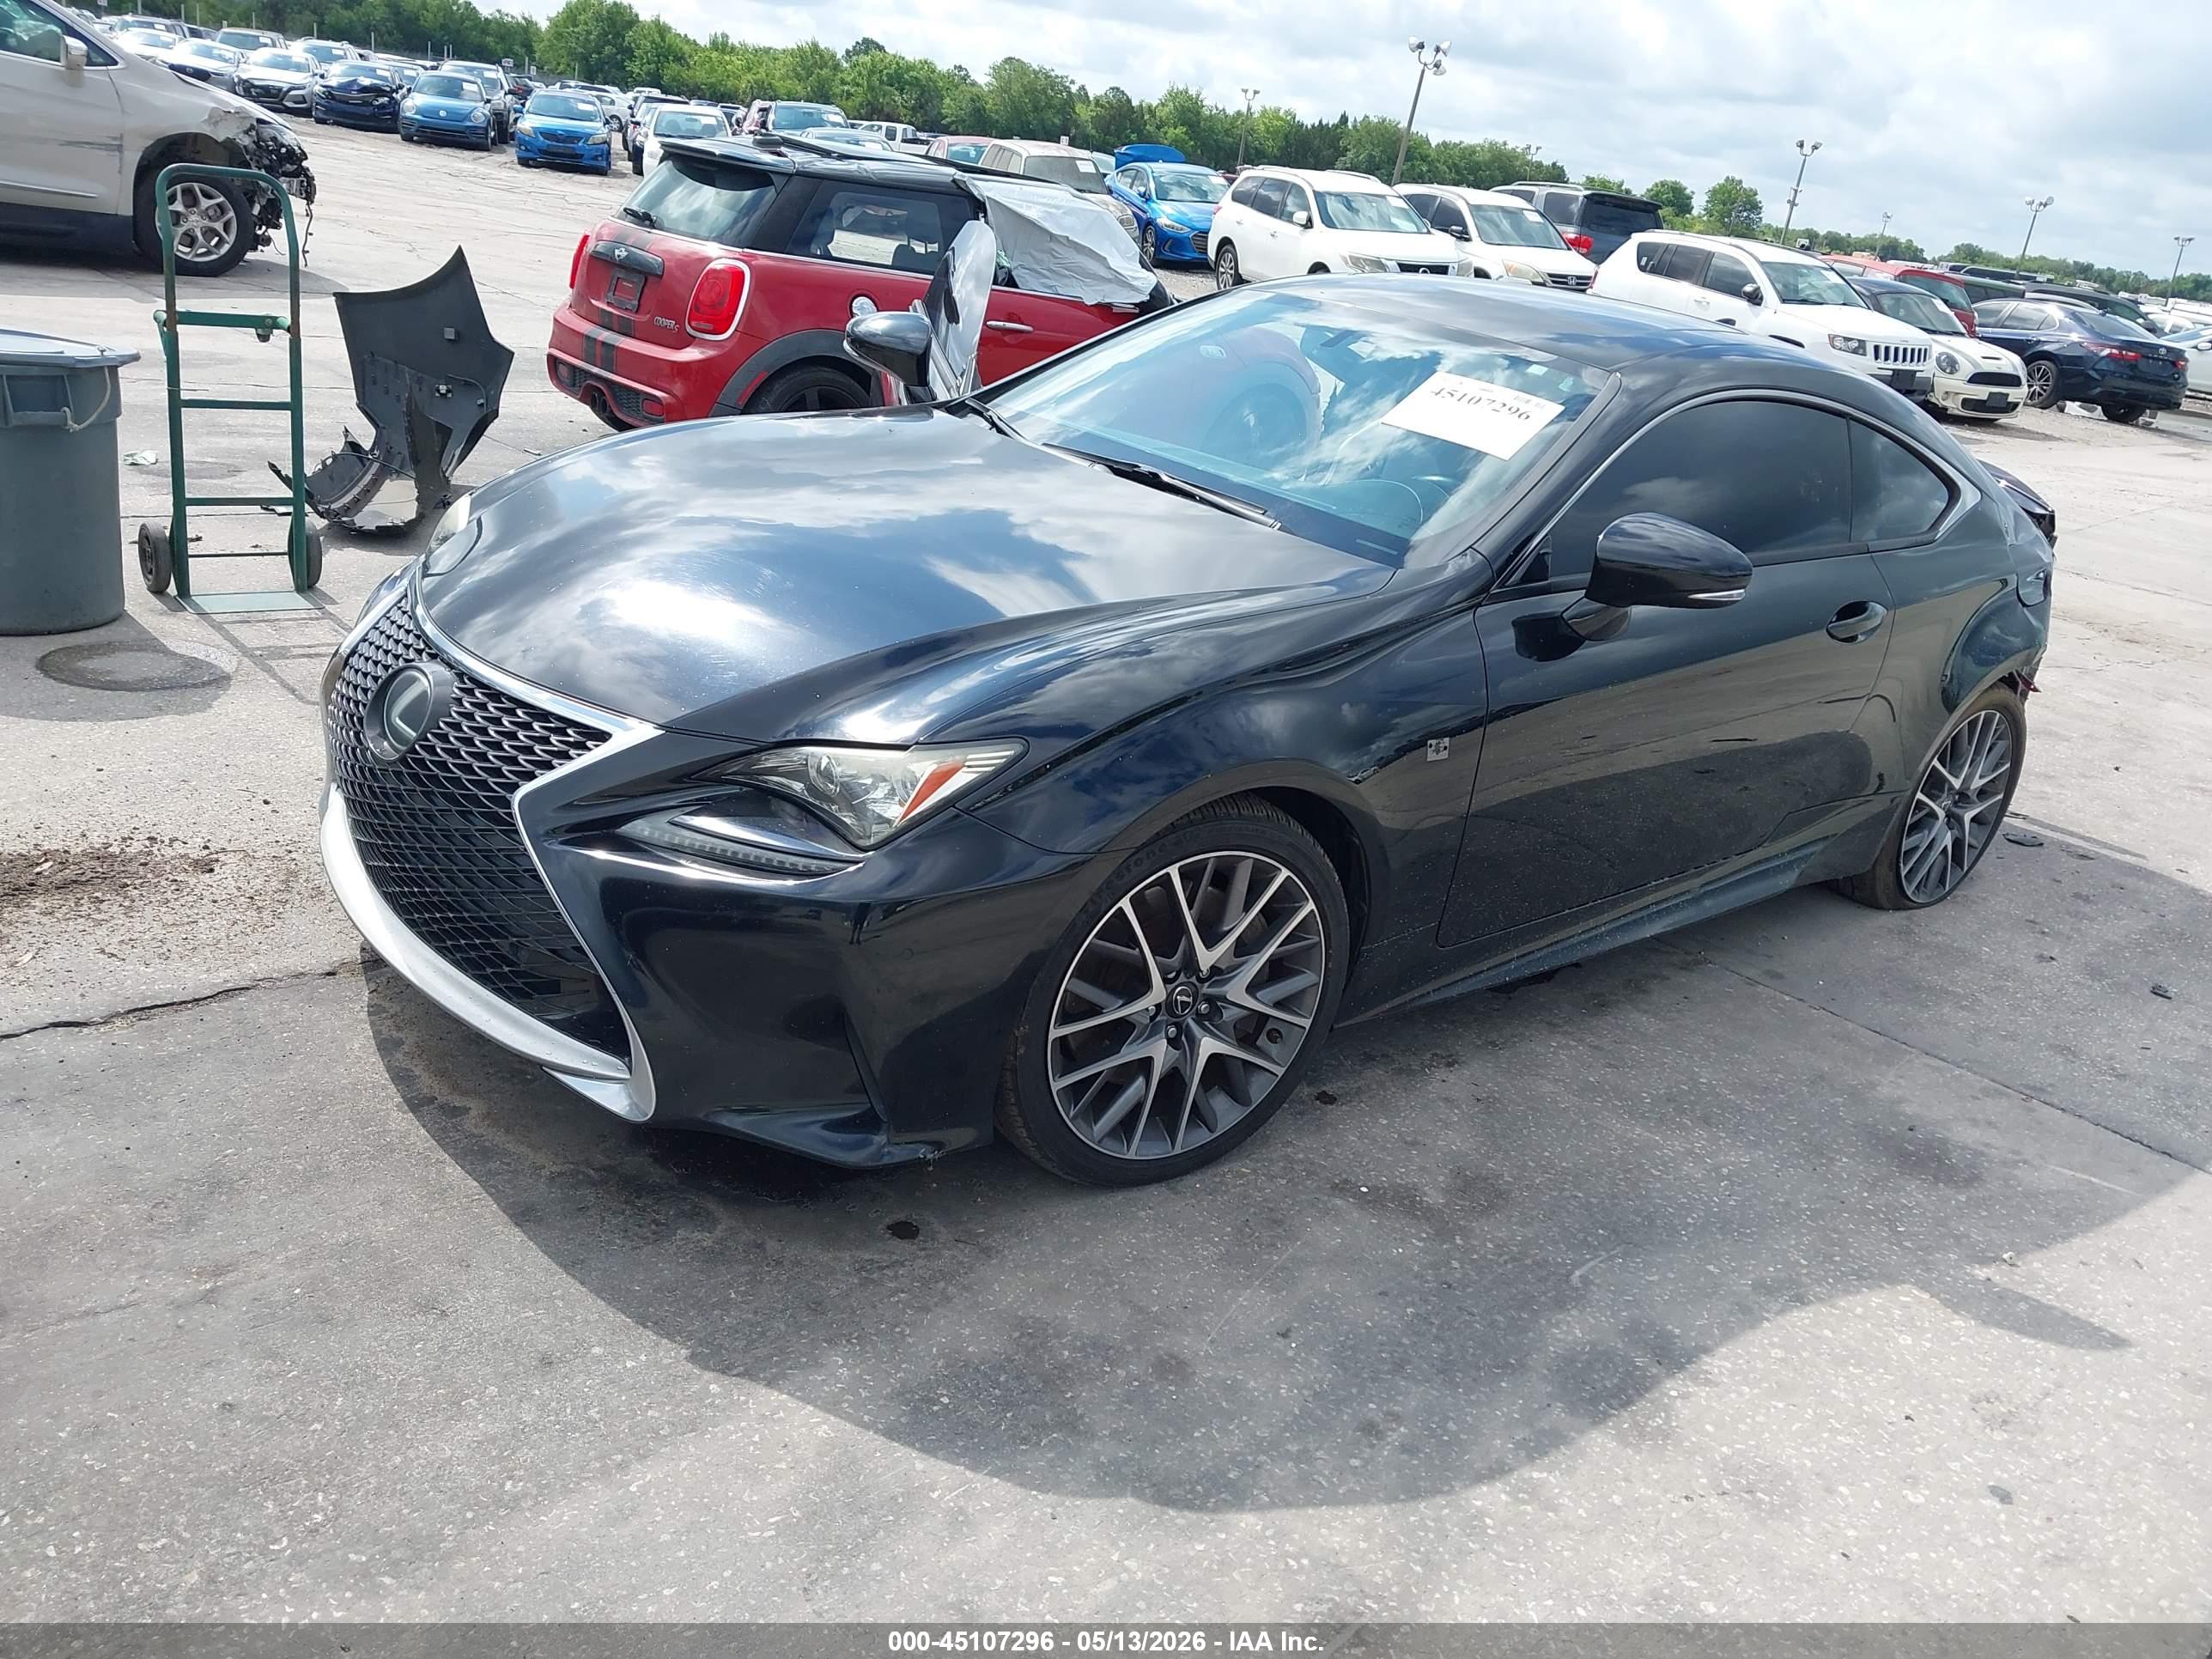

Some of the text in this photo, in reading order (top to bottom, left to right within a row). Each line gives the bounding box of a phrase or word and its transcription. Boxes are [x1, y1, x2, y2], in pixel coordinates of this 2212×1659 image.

[653, 316, 679, 332] COOPER S
[1430, 387, 1531, 421] 45107296
